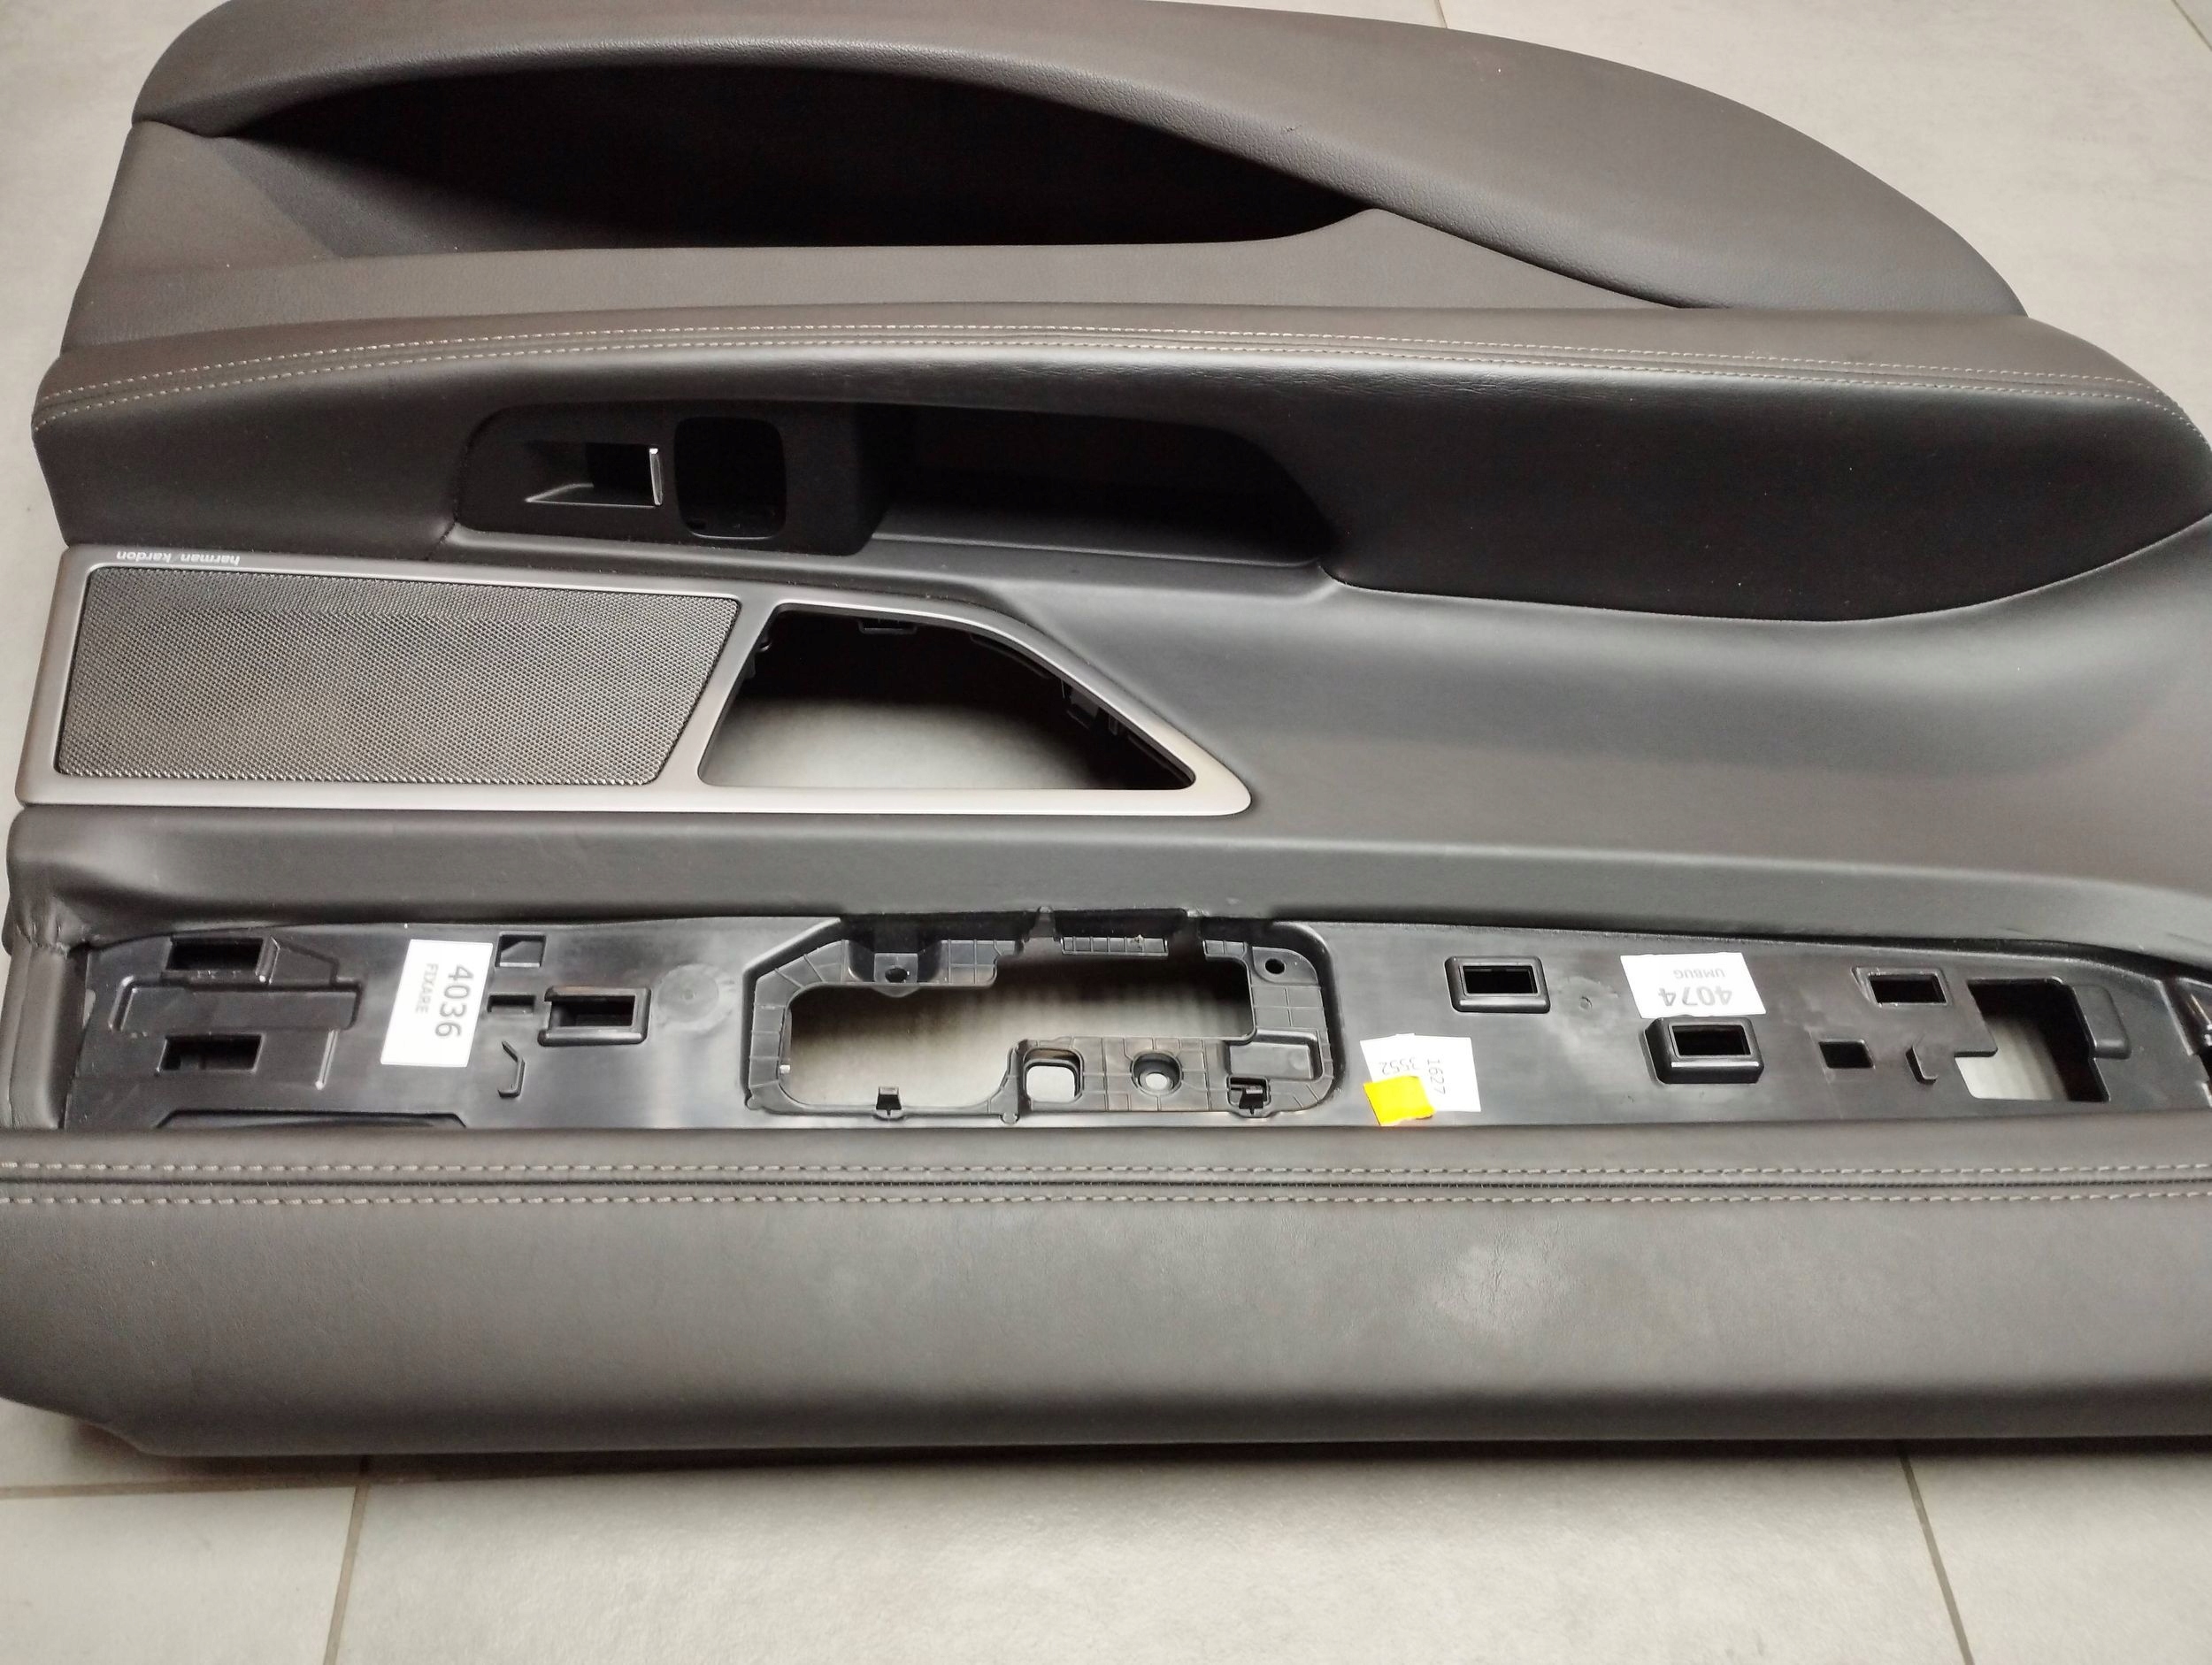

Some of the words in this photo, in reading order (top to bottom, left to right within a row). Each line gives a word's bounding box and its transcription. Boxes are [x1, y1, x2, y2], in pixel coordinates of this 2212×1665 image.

[116, 550, 172, 563] kardon
[180, 552, 241, 565] harman
[1673, 968, 1726, 979] UMBUG
[415, 963, 439, 1014] FIXARE
[1658, 986, 1732, 1007] 4074
[435, 963, 473, 1037] 4036
[1427, 1058, 1446, 1094] 1627
